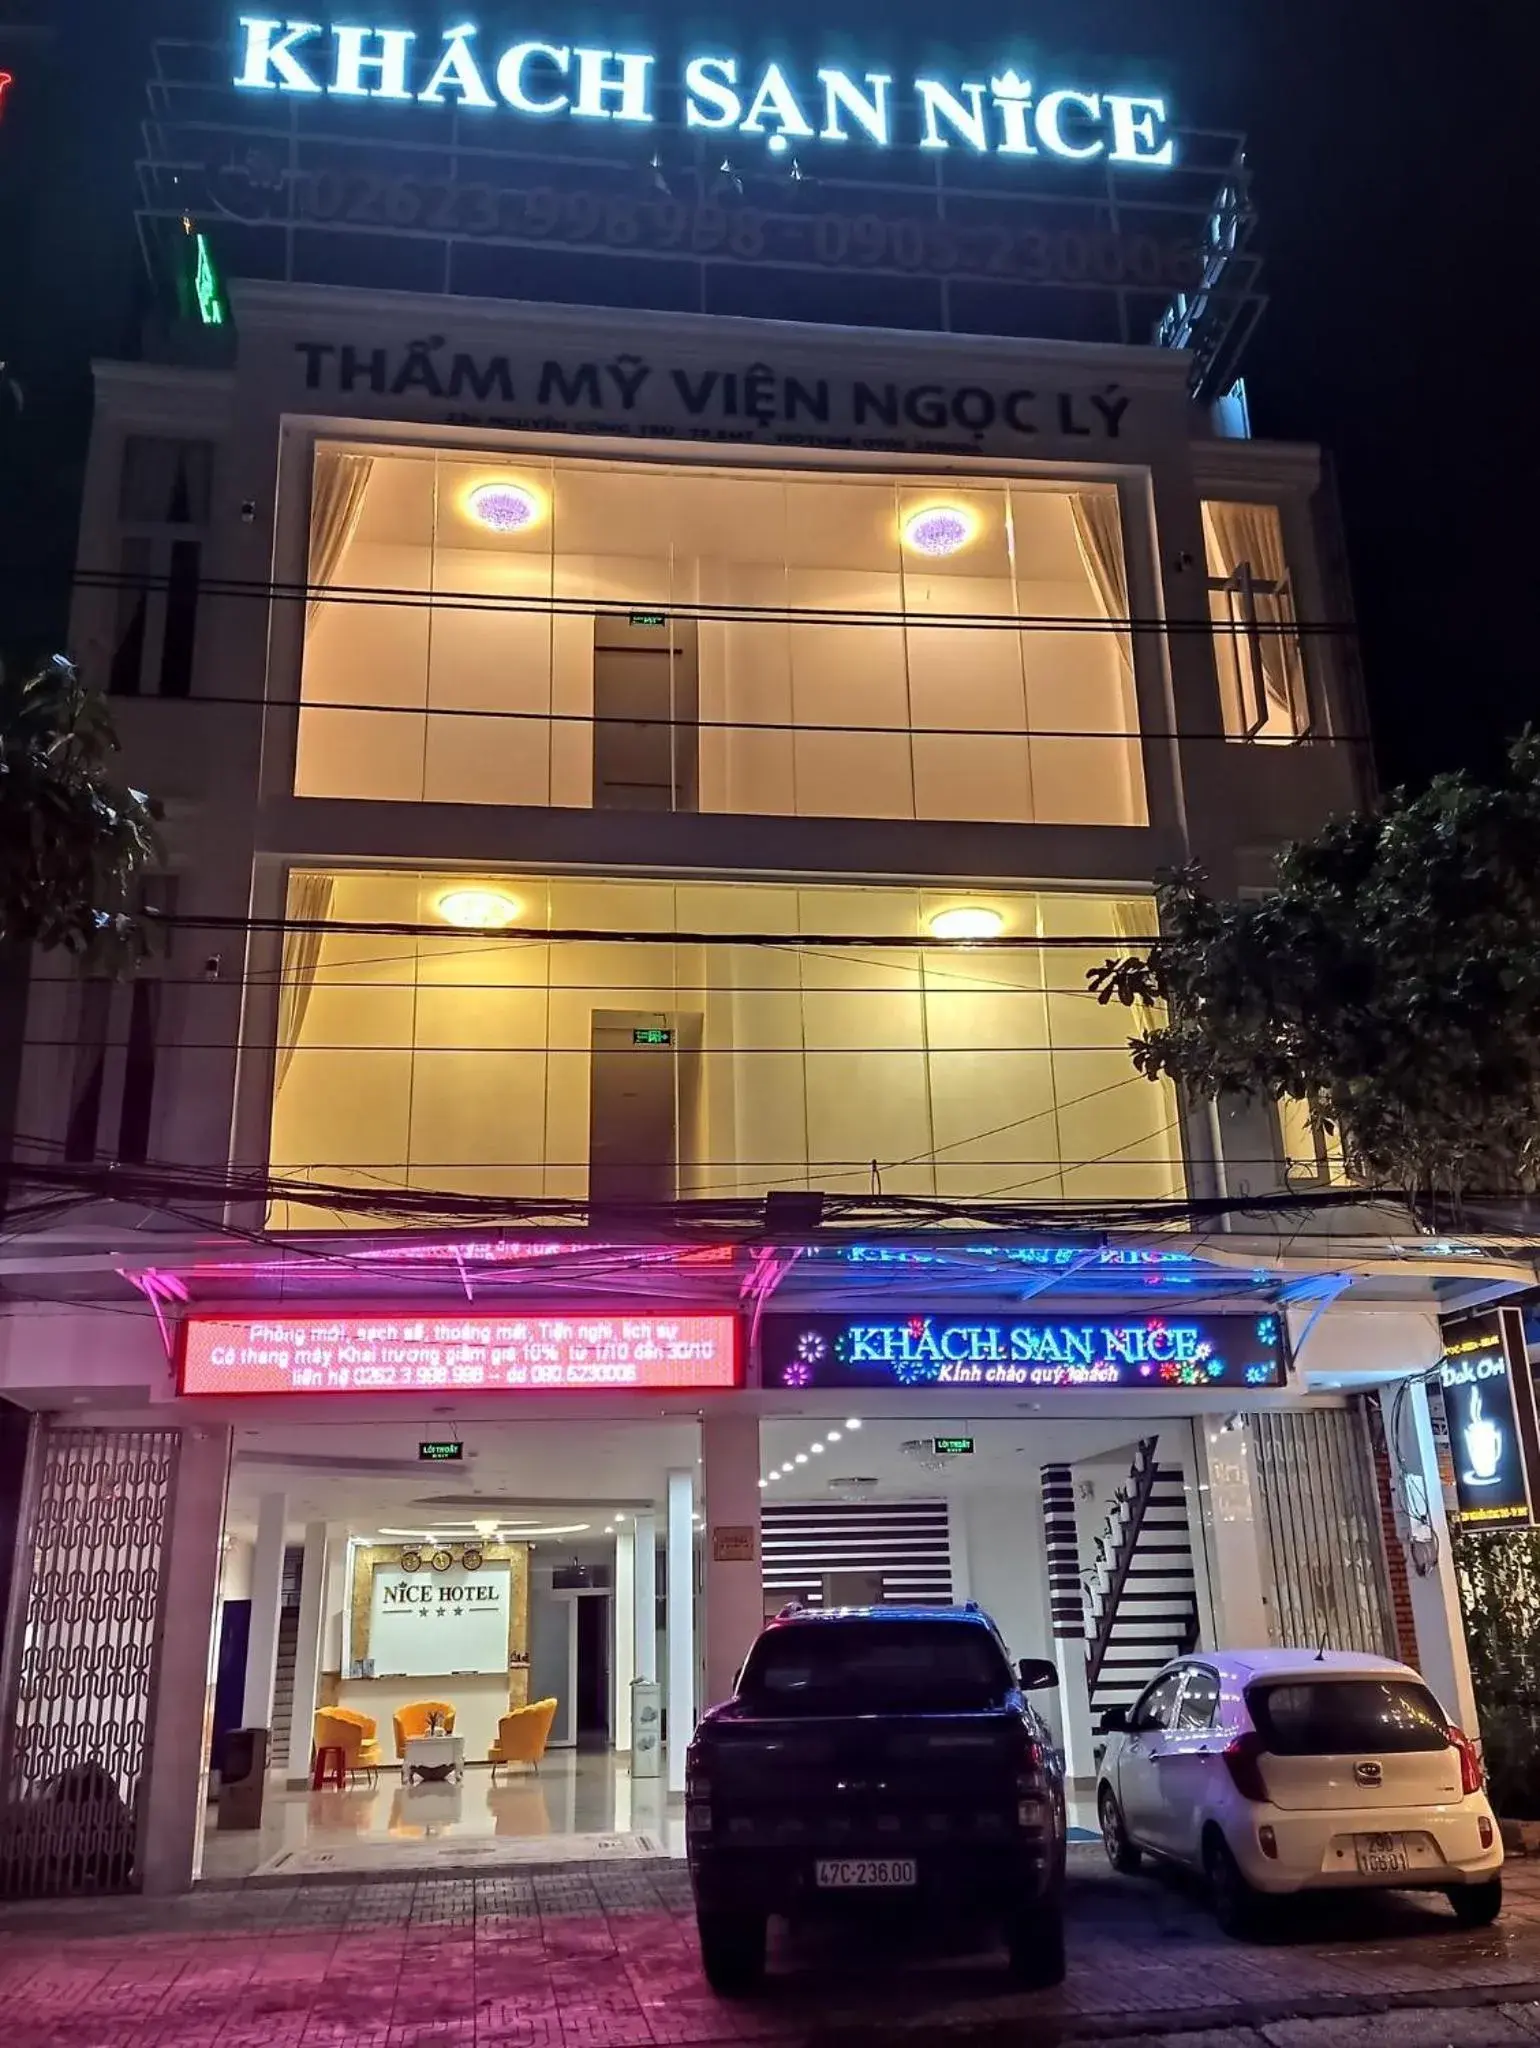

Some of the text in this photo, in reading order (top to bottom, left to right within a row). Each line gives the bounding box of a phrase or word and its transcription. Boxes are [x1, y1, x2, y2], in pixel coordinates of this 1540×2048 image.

[233, 16, 1175, 167] KHÁCH SẠN NICE
[295, 334, 1130, 441] THẨM MỸ VIỆN NGỌC LÝ
[1102, 1328, 1200, 1364] NICE
[383, 1582, 499, 1604] NICE HOTEL
[821, 1862, 913, 1884] 47C-236.00
